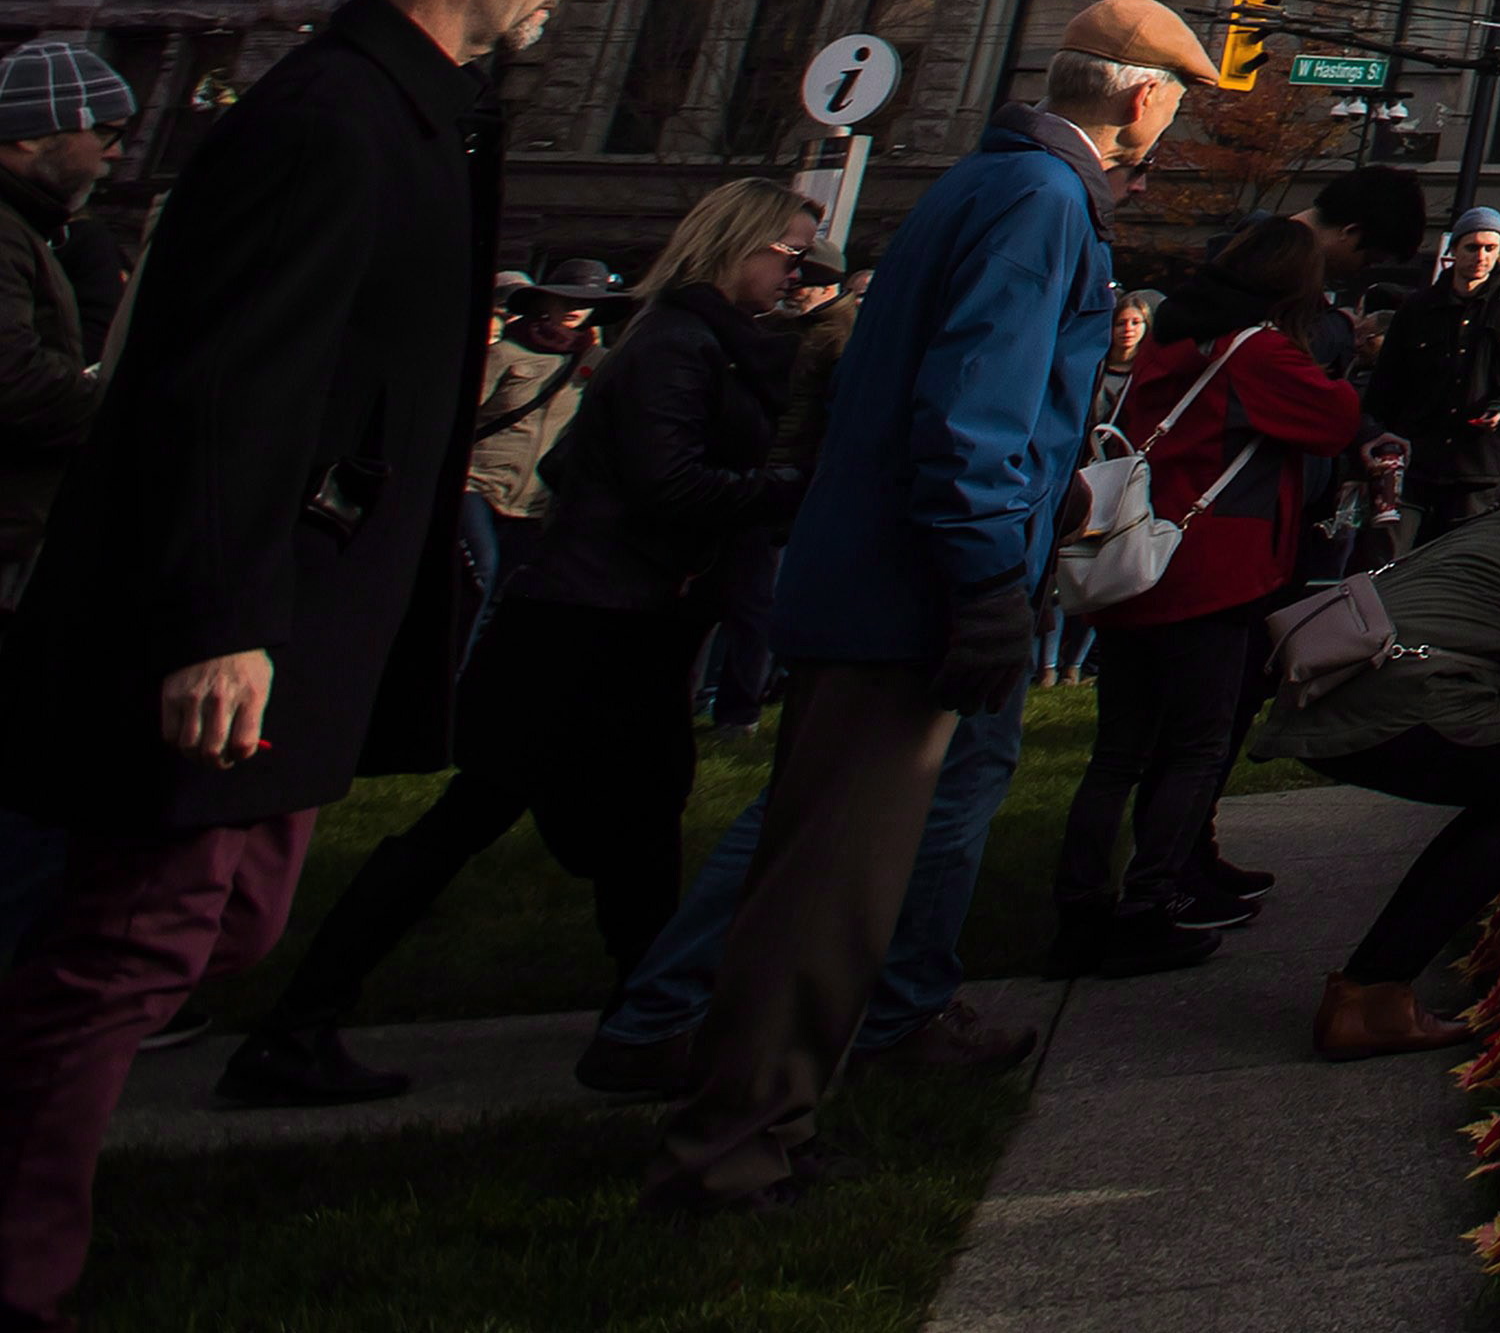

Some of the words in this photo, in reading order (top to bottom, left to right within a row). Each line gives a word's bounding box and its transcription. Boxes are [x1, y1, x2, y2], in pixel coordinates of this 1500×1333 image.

[1298, 59, 1313, 77] W
[1313, 60, 1366, 83] Hastings
[1367, 62, 1383, 80] St
